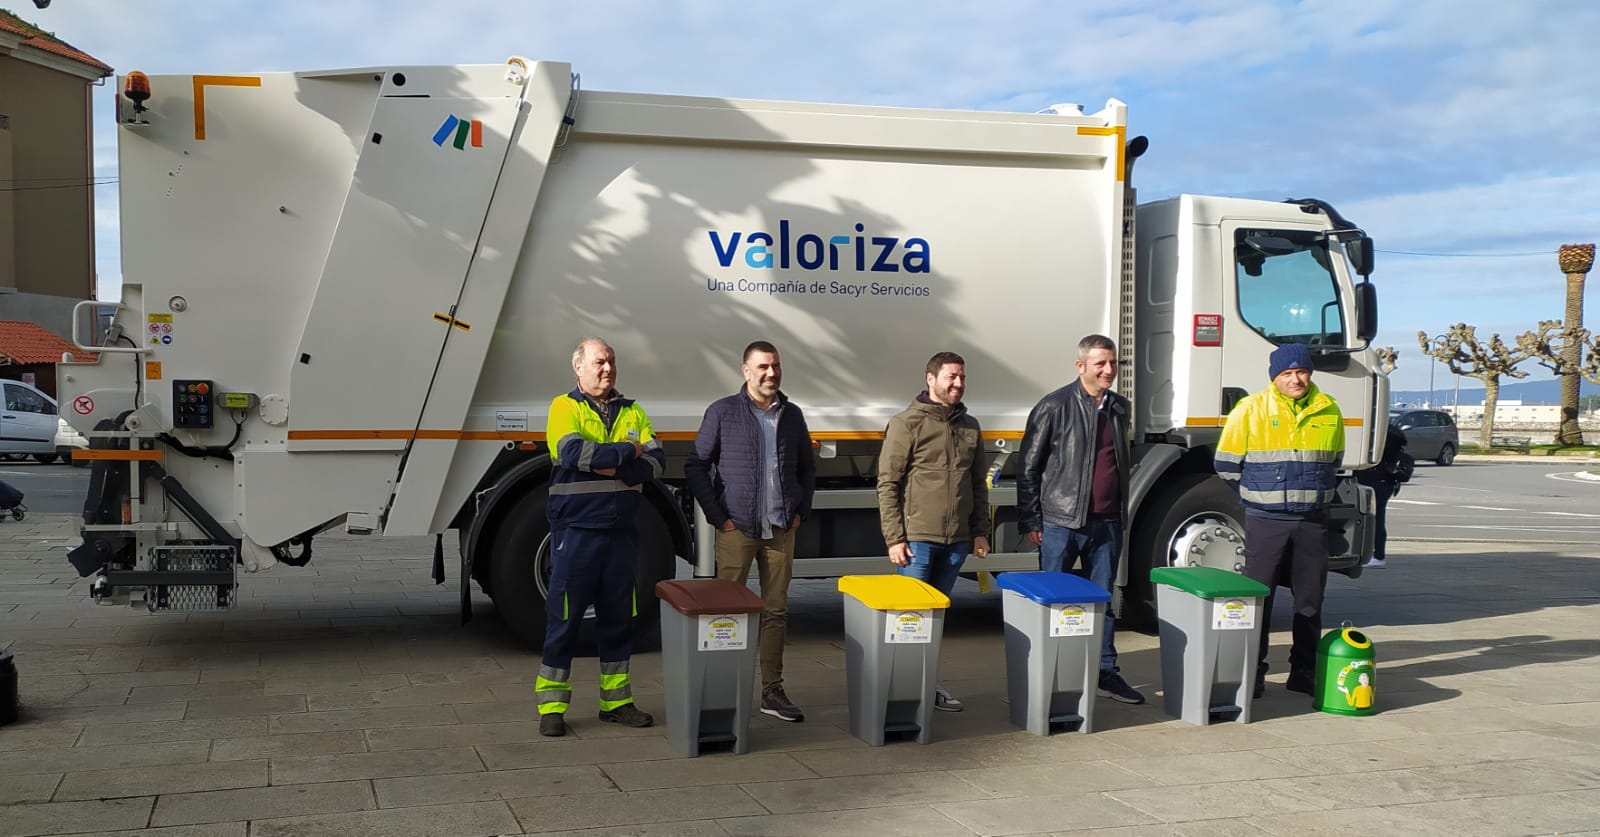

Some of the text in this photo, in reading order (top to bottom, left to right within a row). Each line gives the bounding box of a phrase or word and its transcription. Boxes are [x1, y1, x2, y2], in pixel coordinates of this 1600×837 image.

[708, 219, 931, 273] valoriza
[707, 278, 930, 297] Una Compañía de Sacyr Servicios
